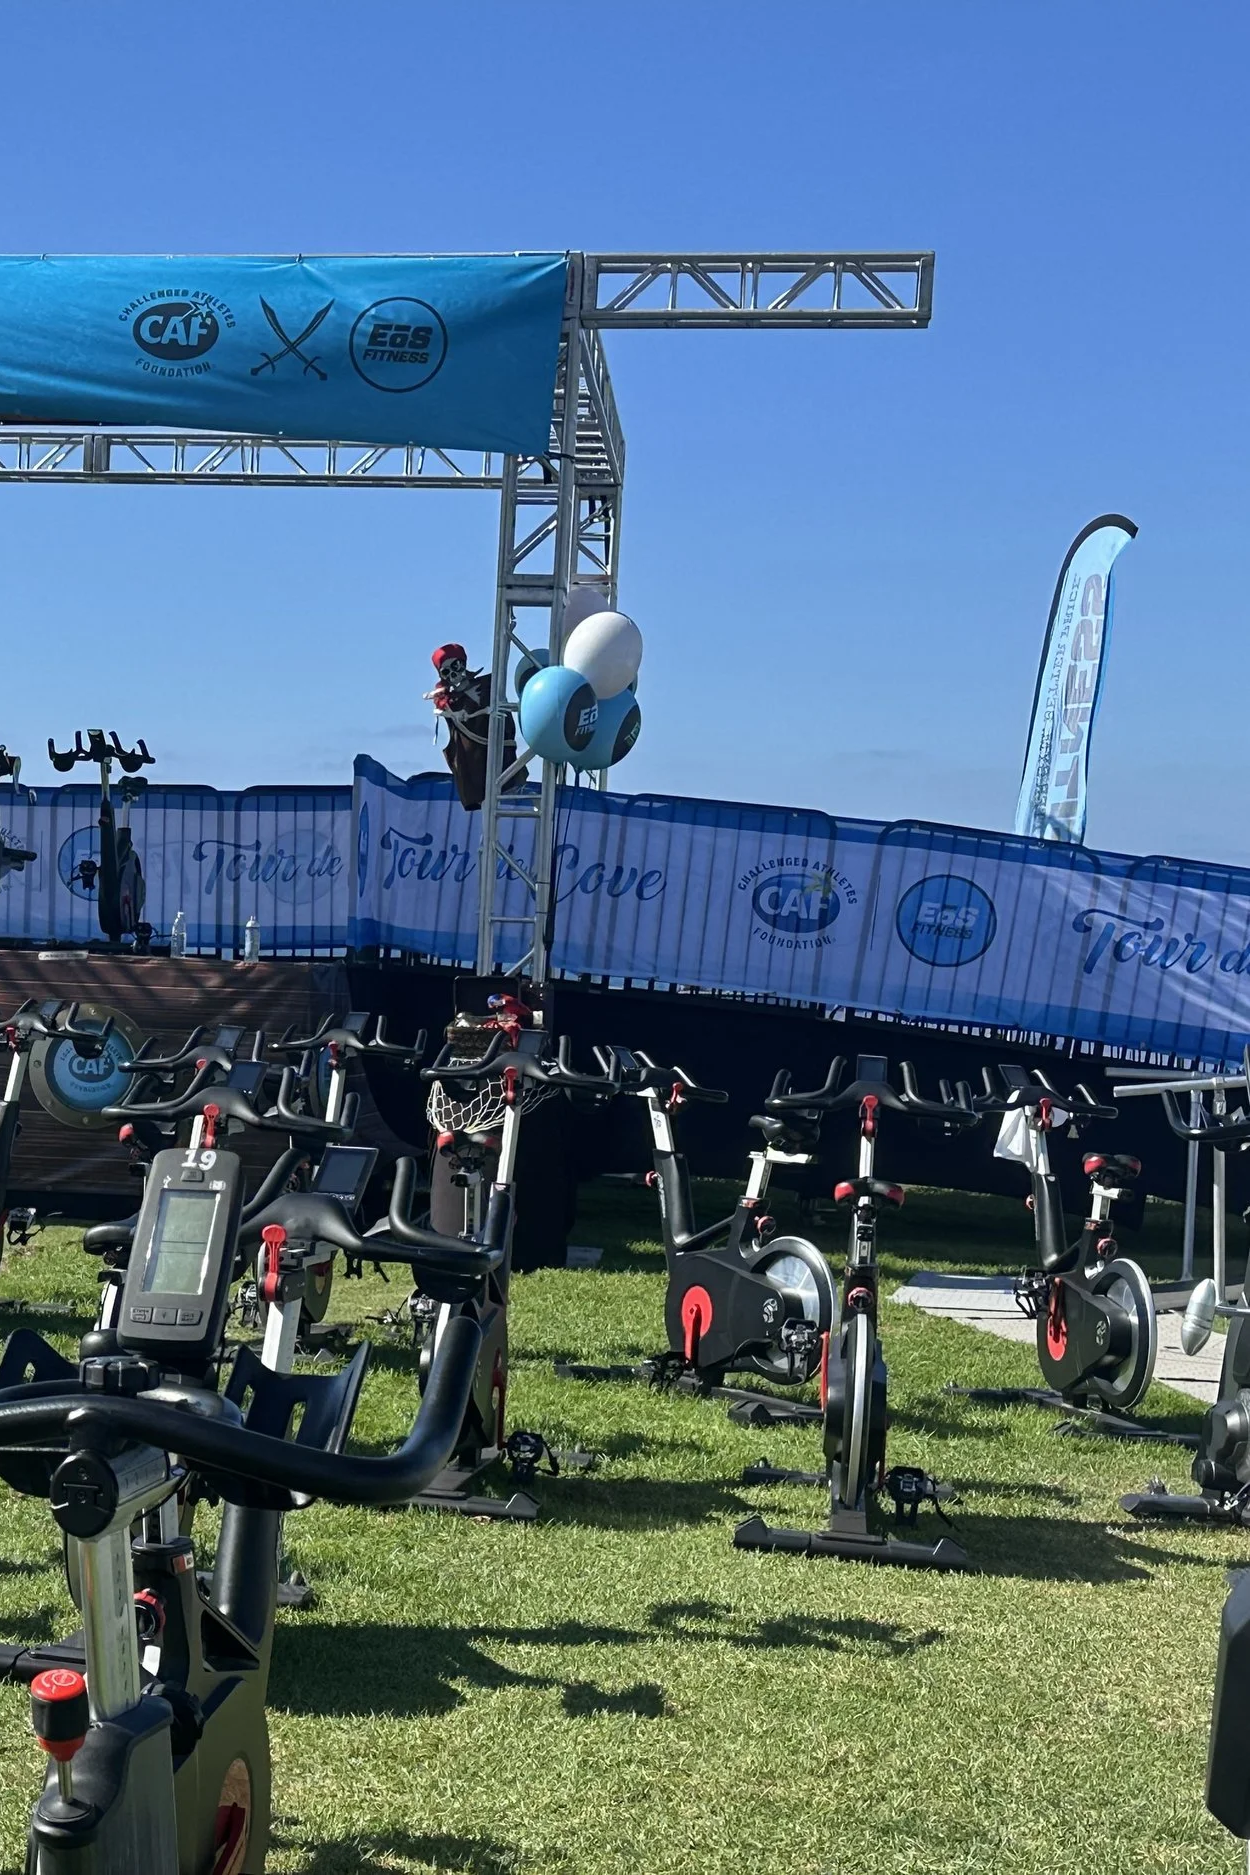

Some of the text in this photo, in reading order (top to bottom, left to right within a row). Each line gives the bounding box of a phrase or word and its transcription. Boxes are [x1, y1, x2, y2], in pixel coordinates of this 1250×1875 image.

[118, 288, 237, 329] CHALLENGED ATHLETES
[139, 314, 209, 347] CAF
[135, 357, 212, 378] FOUNDATION
[362, 348, 430, 365] FITNESS
[192, 839, 299, 896] Tour
[305, 844, 344, 878] de
[380, 826, 477, 890] Tour
[737, 857, 858, 905] CHALLENGED ATHLETES
[759, 885, 833, 921] CAF
[753, 927, 832, 950] FOUNDATION
[910, 922, 974, 940] FITNESS
[1072, 908, 1250, 975] Tour d
[71, 1056, 109, 1075] CAF
[181, 1149, 218, 1171] 19
